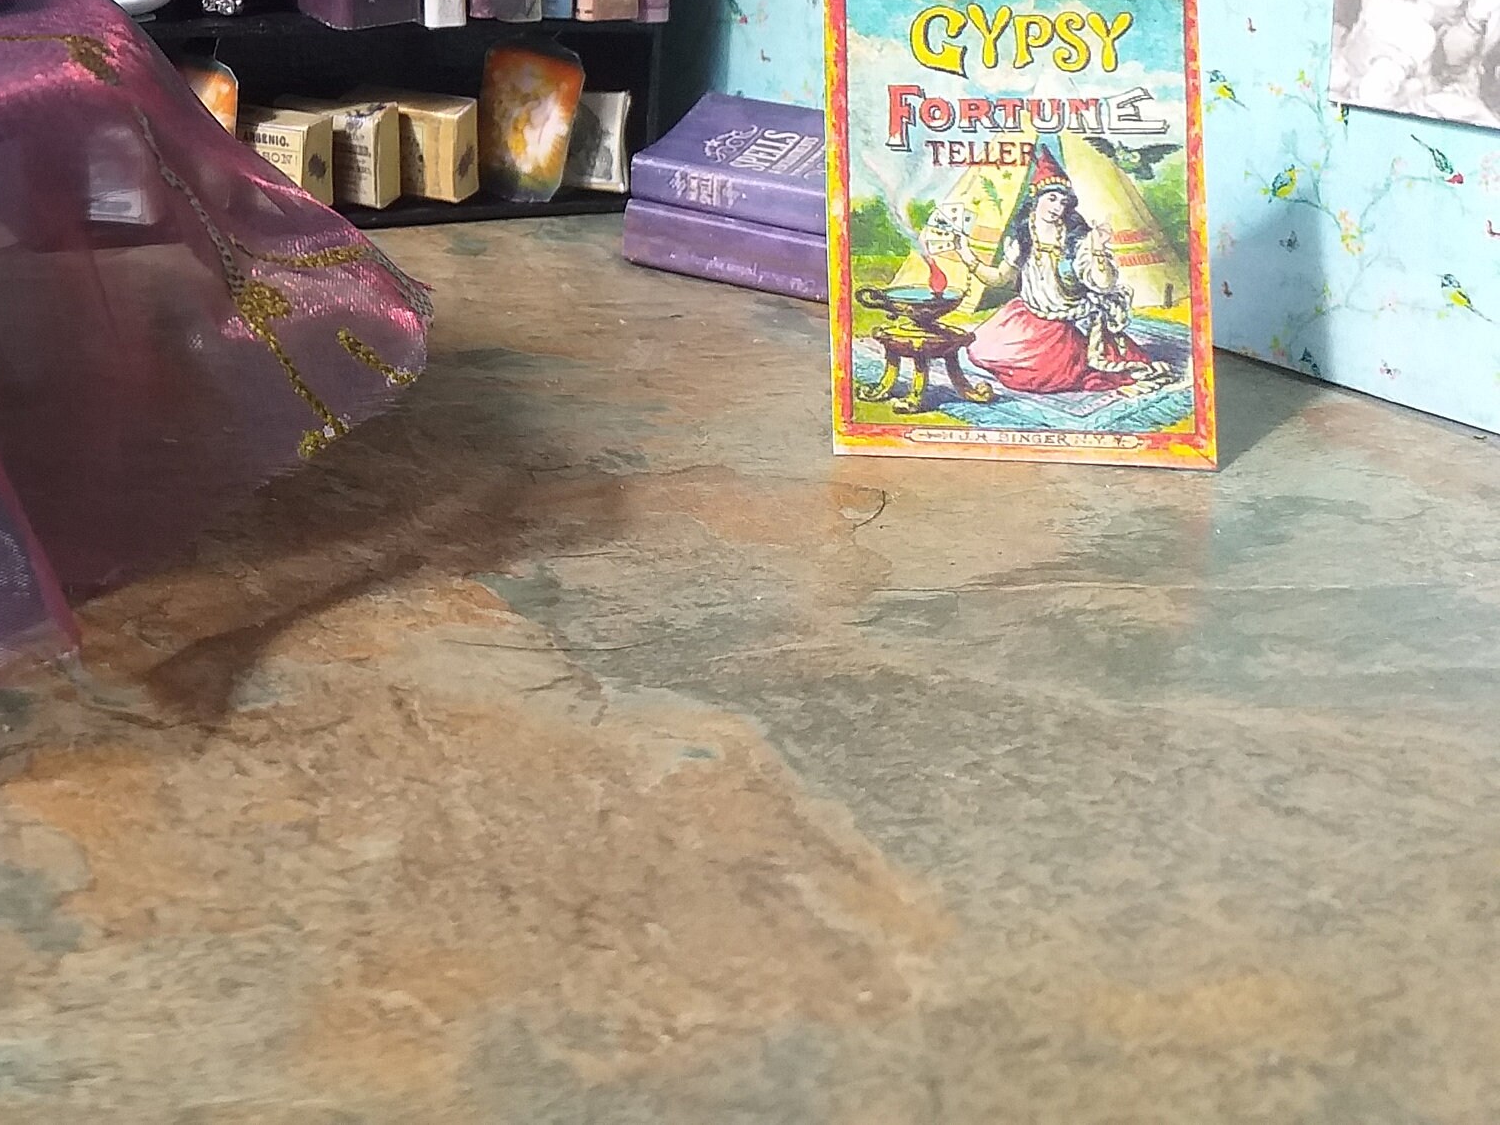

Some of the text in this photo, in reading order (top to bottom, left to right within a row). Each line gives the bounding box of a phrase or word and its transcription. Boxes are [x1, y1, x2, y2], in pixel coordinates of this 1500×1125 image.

[910, 3, 1134, 79] GYPSY
[886, 84, 1171, 152] FORTUNE
[730, 129, 802, 172] SPELLS
[925, 140, 1036, 168] TELLER
